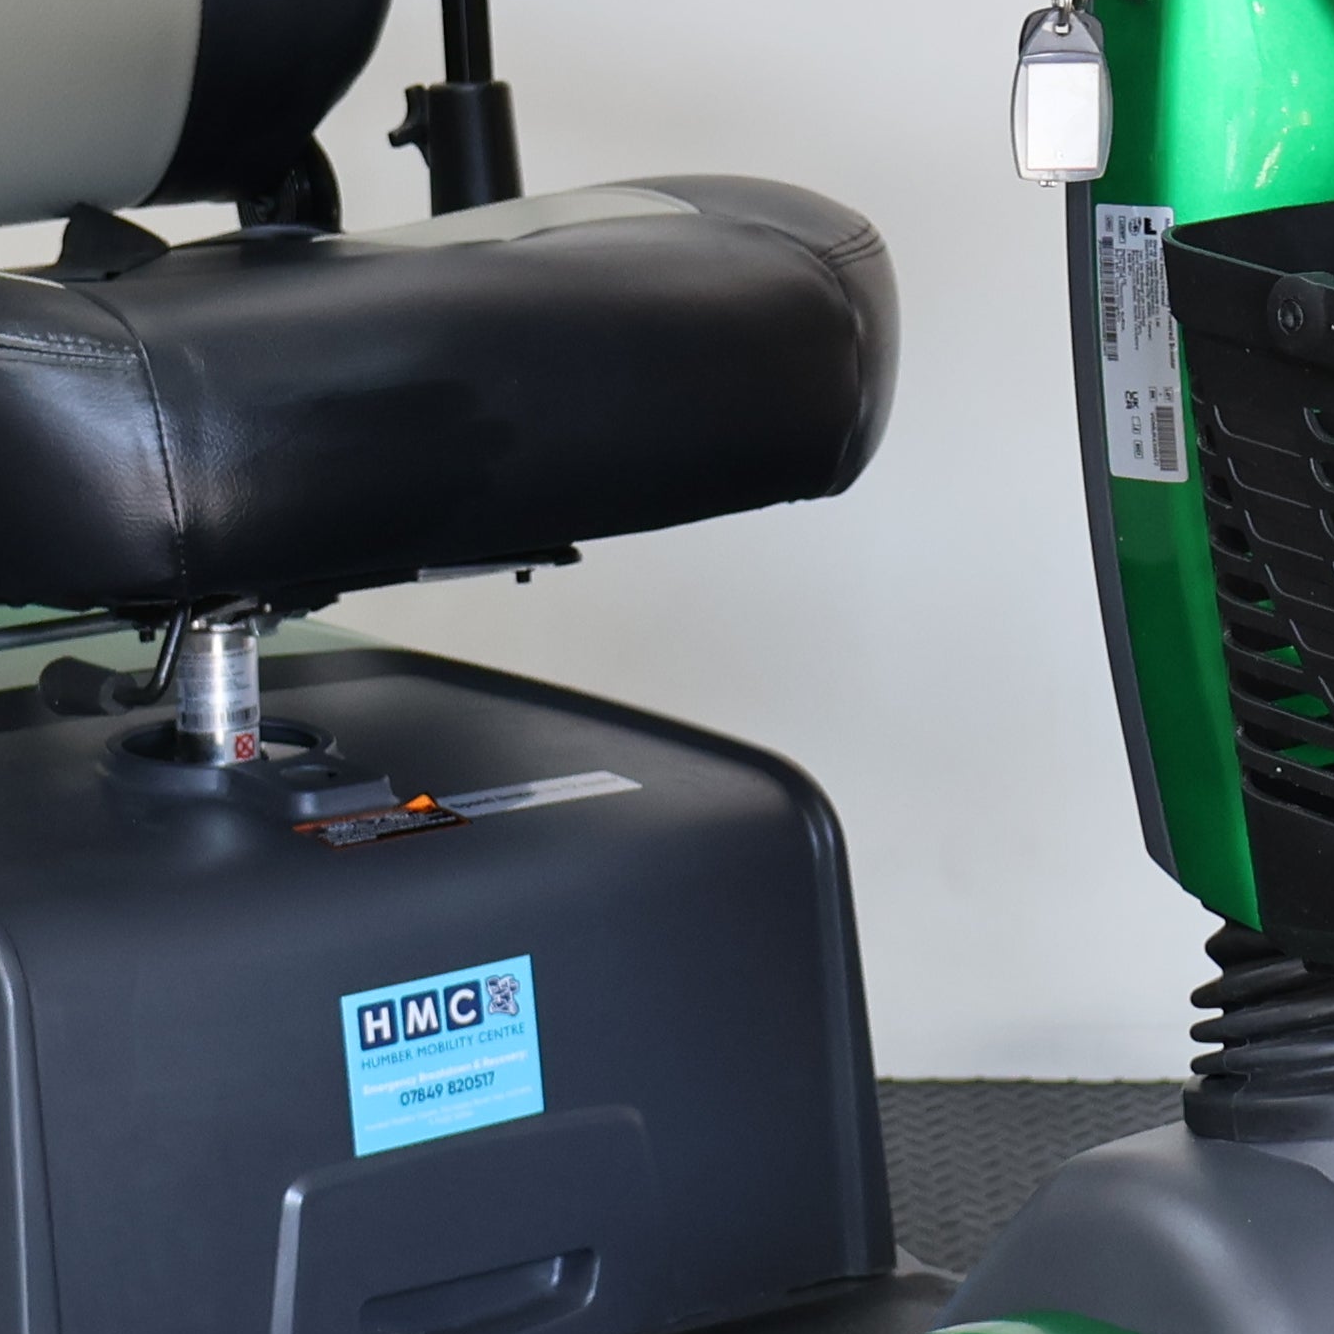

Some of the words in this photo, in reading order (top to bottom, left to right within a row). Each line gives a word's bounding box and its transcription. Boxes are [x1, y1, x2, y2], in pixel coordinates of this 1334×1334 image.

[363, 987, 478, 1045] HMC
[361, 1050, 414, 1071] HUMBER
[417, 1036, 474, 1058] MOBILITY
[478, 1022, 526, 1044] CENTRE
[399, 1084, 444, 1106] 07849
[447, 1071, 496, 1094] 820517
